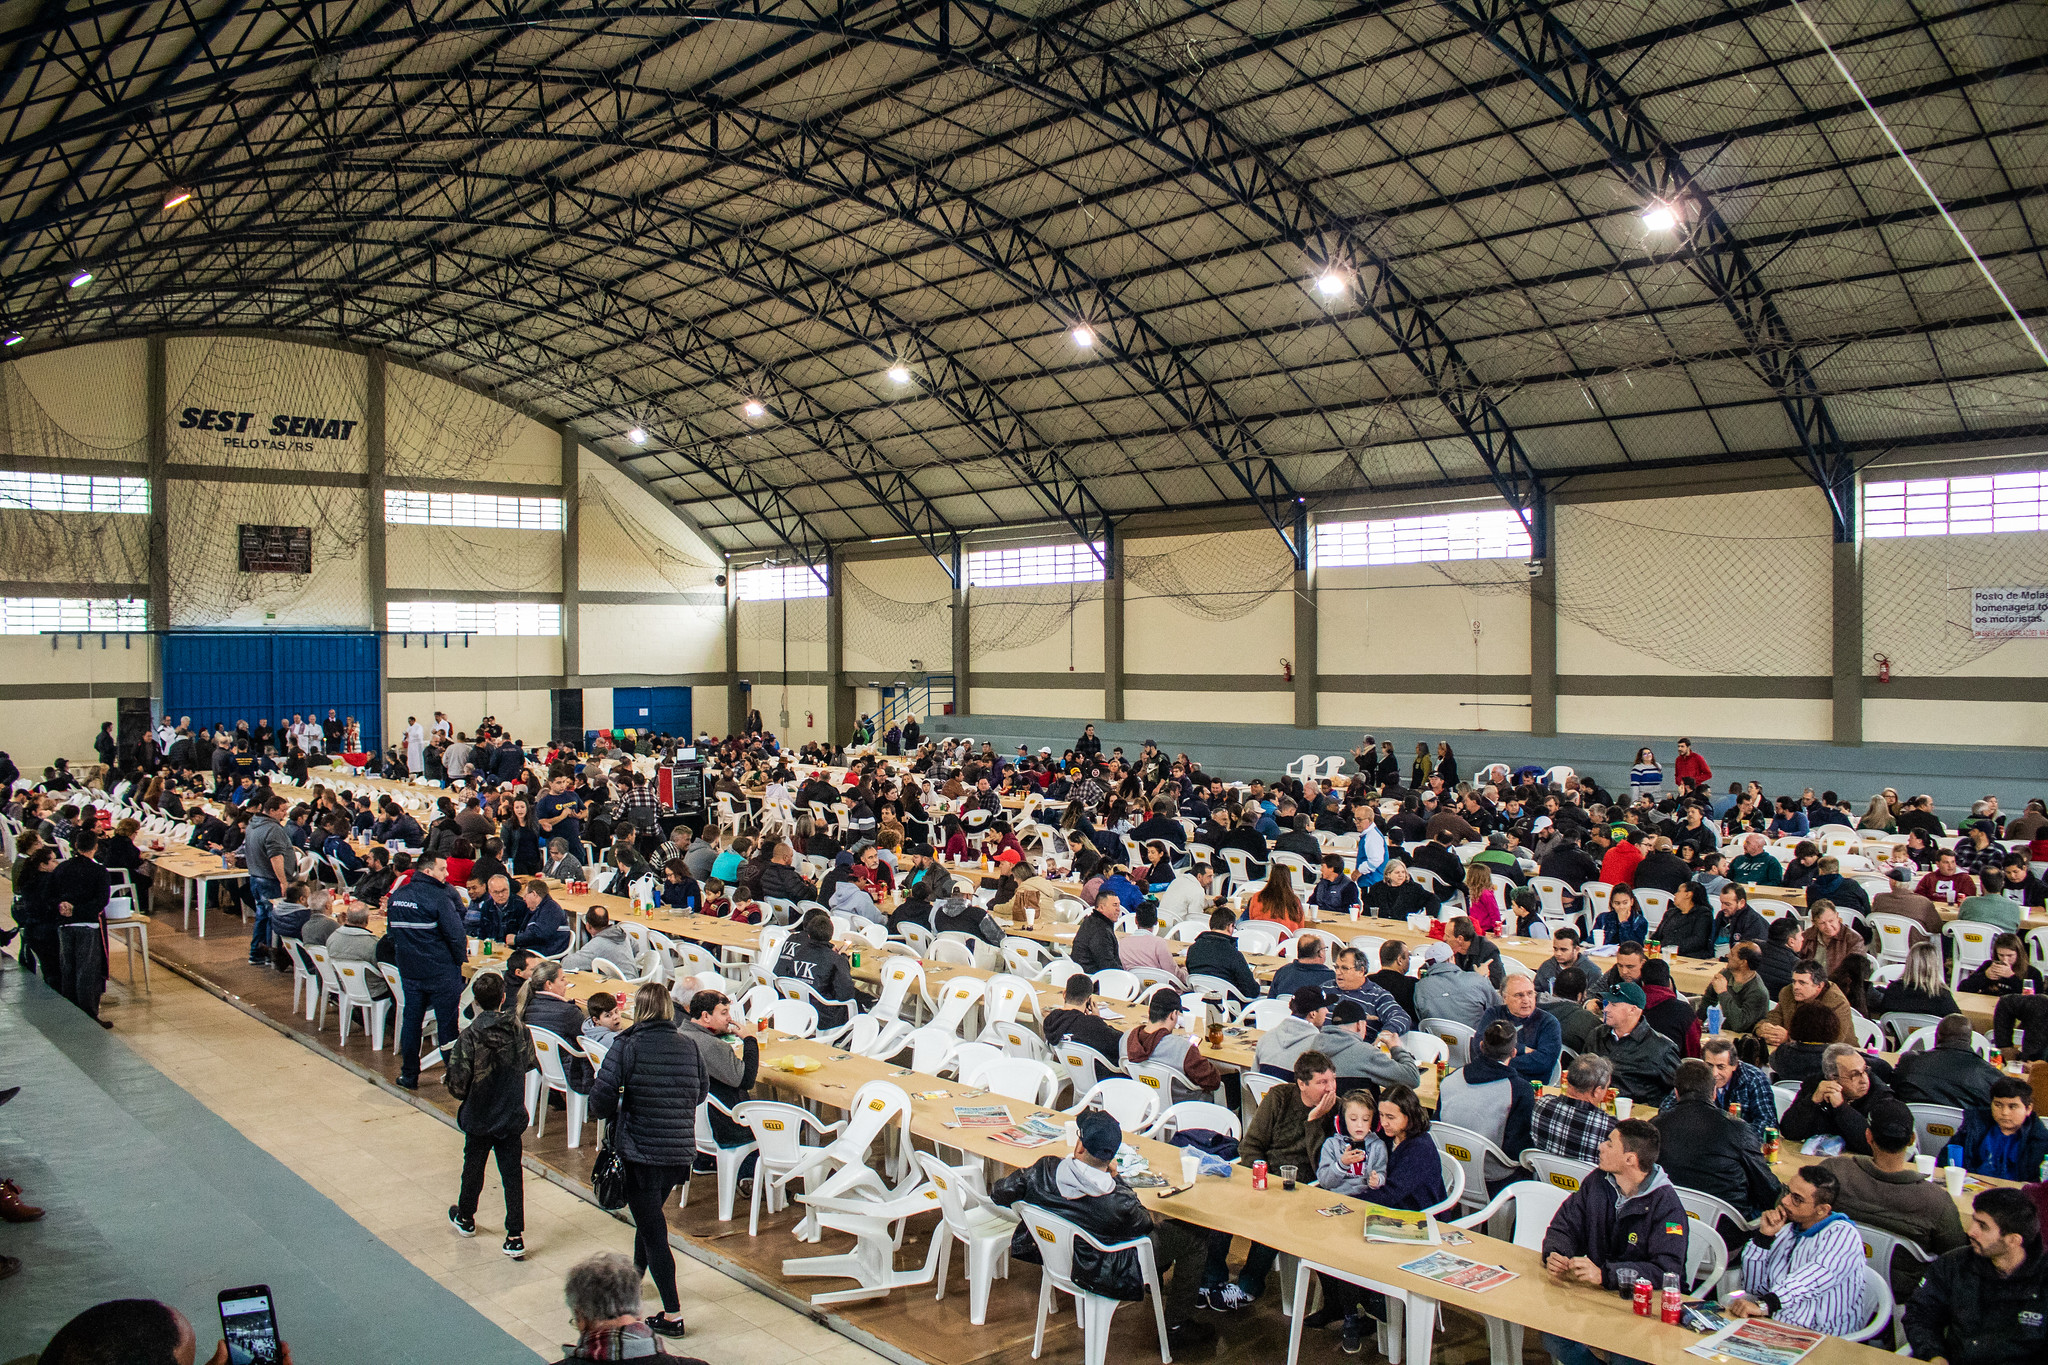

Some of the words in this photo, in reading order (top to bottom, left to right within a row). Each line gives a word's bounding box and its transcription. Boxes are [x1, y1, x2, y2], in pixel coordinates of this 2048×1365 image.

[179, 407, 254, 433] SEST
[268, 414, 358, 441] SENAT
[223, 437, 314, 452] PELOTAS/RS
[1975, 592, 2004, 600] Posto
[2006, 592, 2018, 600] de
[1975, 603, 2035, 613] homenageia
[782, 941, 801, 957] VK
[793, 960, 818, 980] VK
[1448, 1146, 1468, 1159] GELEI
[1552, 1175, 1576, 1188] GELEI
